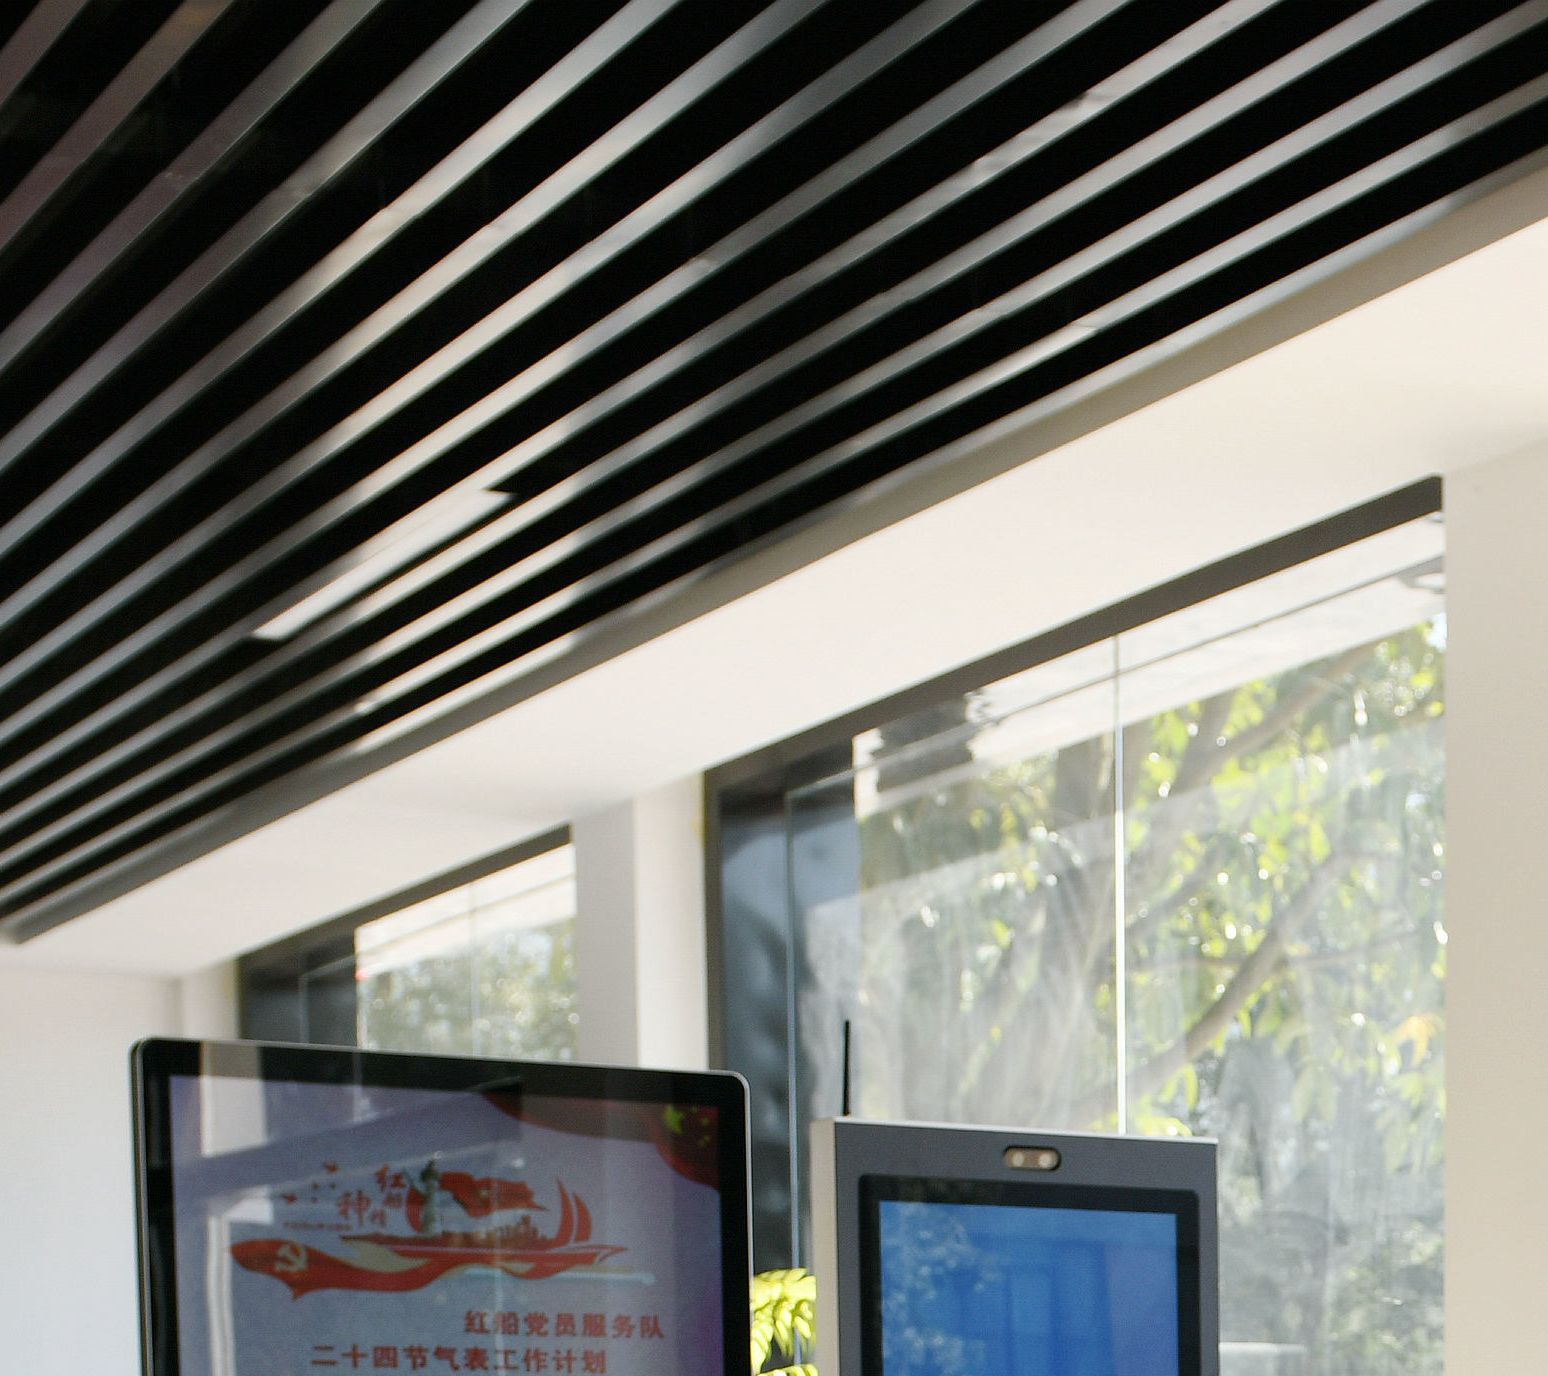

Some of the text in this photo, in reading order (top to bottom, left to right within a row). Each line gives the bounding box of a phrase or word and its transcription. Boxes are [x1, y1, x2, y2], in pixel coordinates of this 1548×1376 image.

[464, 1309, 665, 1340] 红船党员服务队
[311, 1343, 607, 1375] 二十四节气表工作计划
